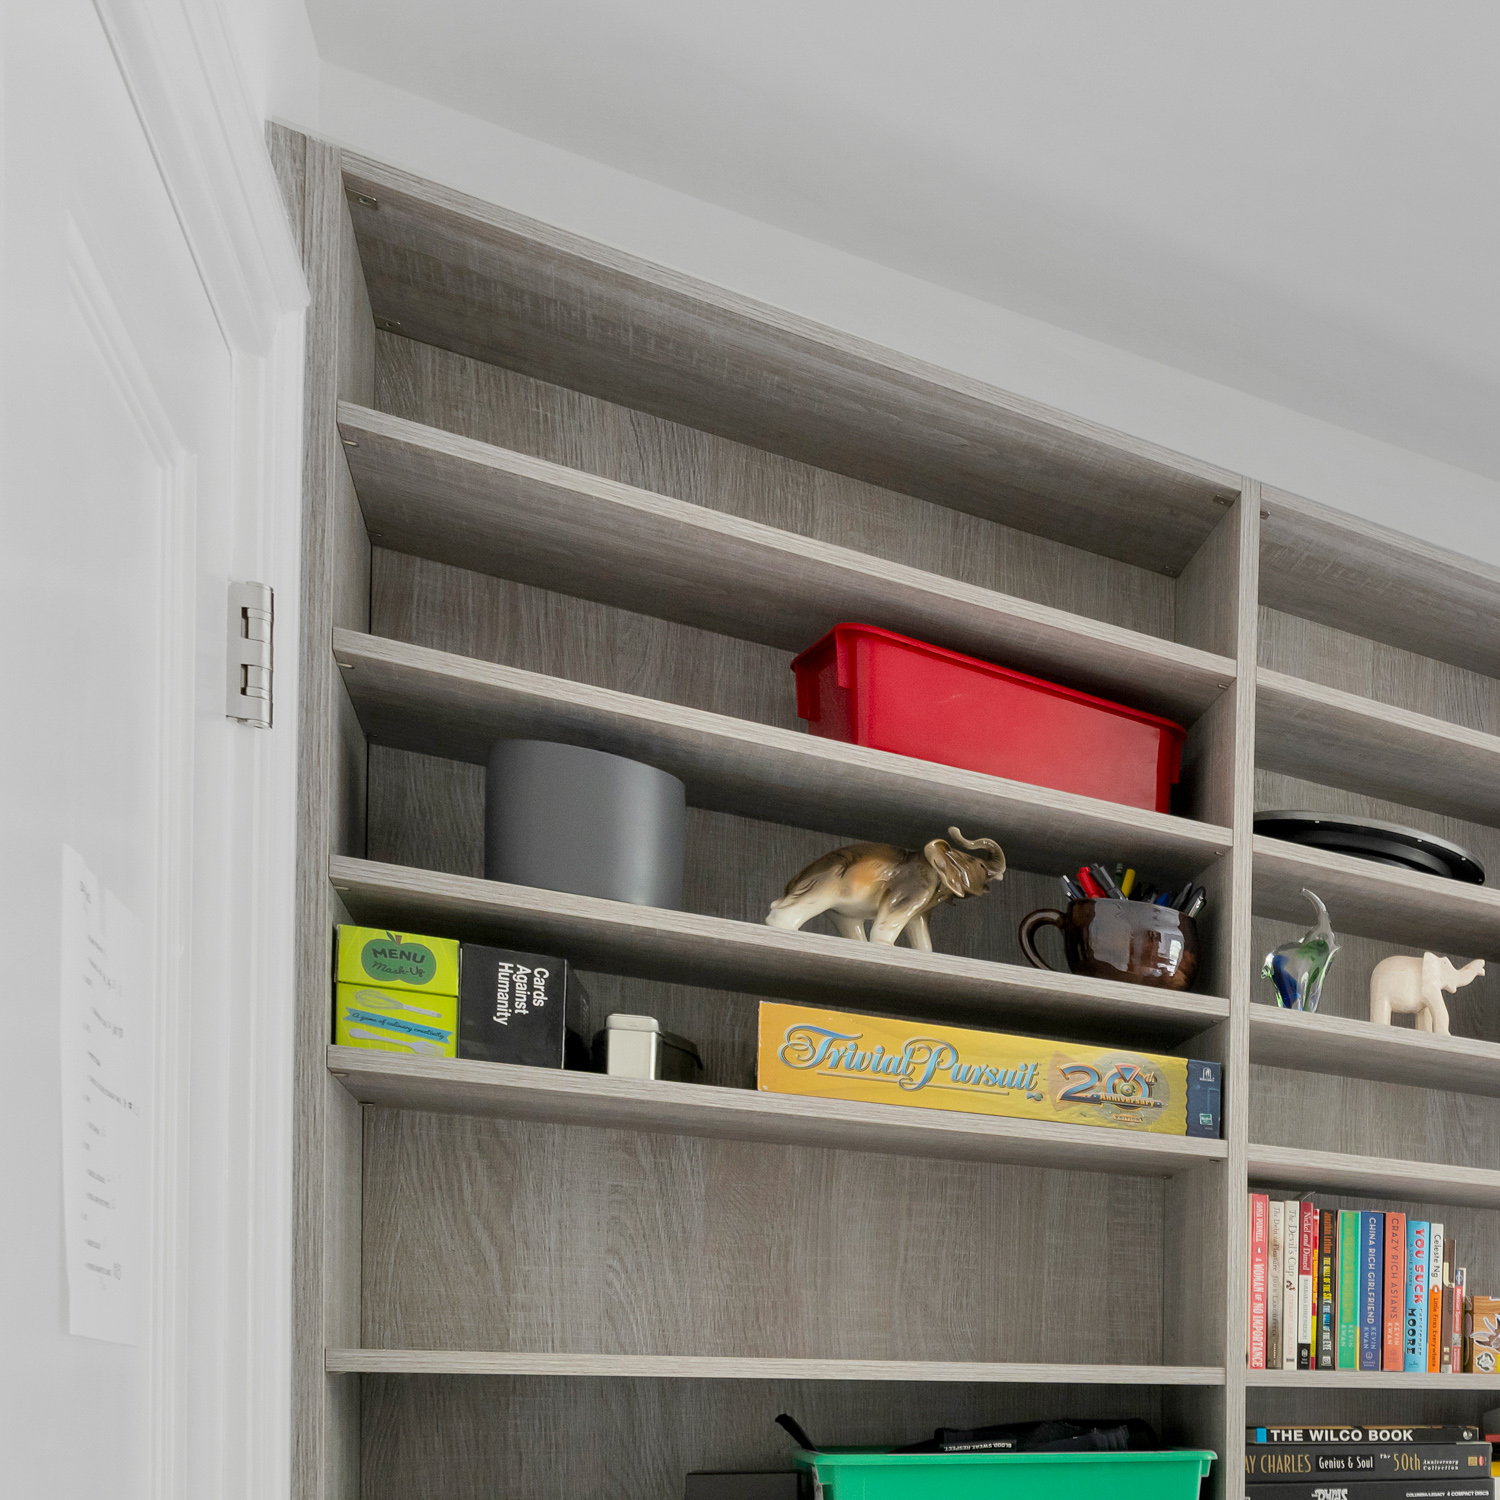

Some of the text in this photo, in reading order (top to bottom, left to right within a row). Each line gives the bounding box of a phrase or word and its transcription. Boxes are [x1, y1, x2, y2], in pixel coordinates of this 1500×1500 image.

[372, 947, 426, 964] MENU
[493, 962, 514, 1026] Humanity
[514, 964, 529, 1015] Against
[532, 967, 549, 1007] Cards
[778, 1024, 1041, 1092] Trivial Pursuit
[1098, 1091, 1156, 1108] Anniversary
[1391, 1218, 1399, 1250] CRAZY
[1366, 1217, 1376, 1325] CHINA RICH GIRLFRIEND
[1413, 1229, 1425, 1304] YOU SUCK
[1431, 1234, 1441, 1278] Celeste Ng
[1389, 1280, 1398, 1319] ASIANS
[1406, 1308, 1416, 1355] MOORE
[1271, 1429, 1413, 1442] THE WILCO BOOK
[1260, 1453, 1312, 1474] CHARLES
[1318, 1455, 1374, 1471] Genius & Soul
[1393, 1452, 1421, 1472] 50th
